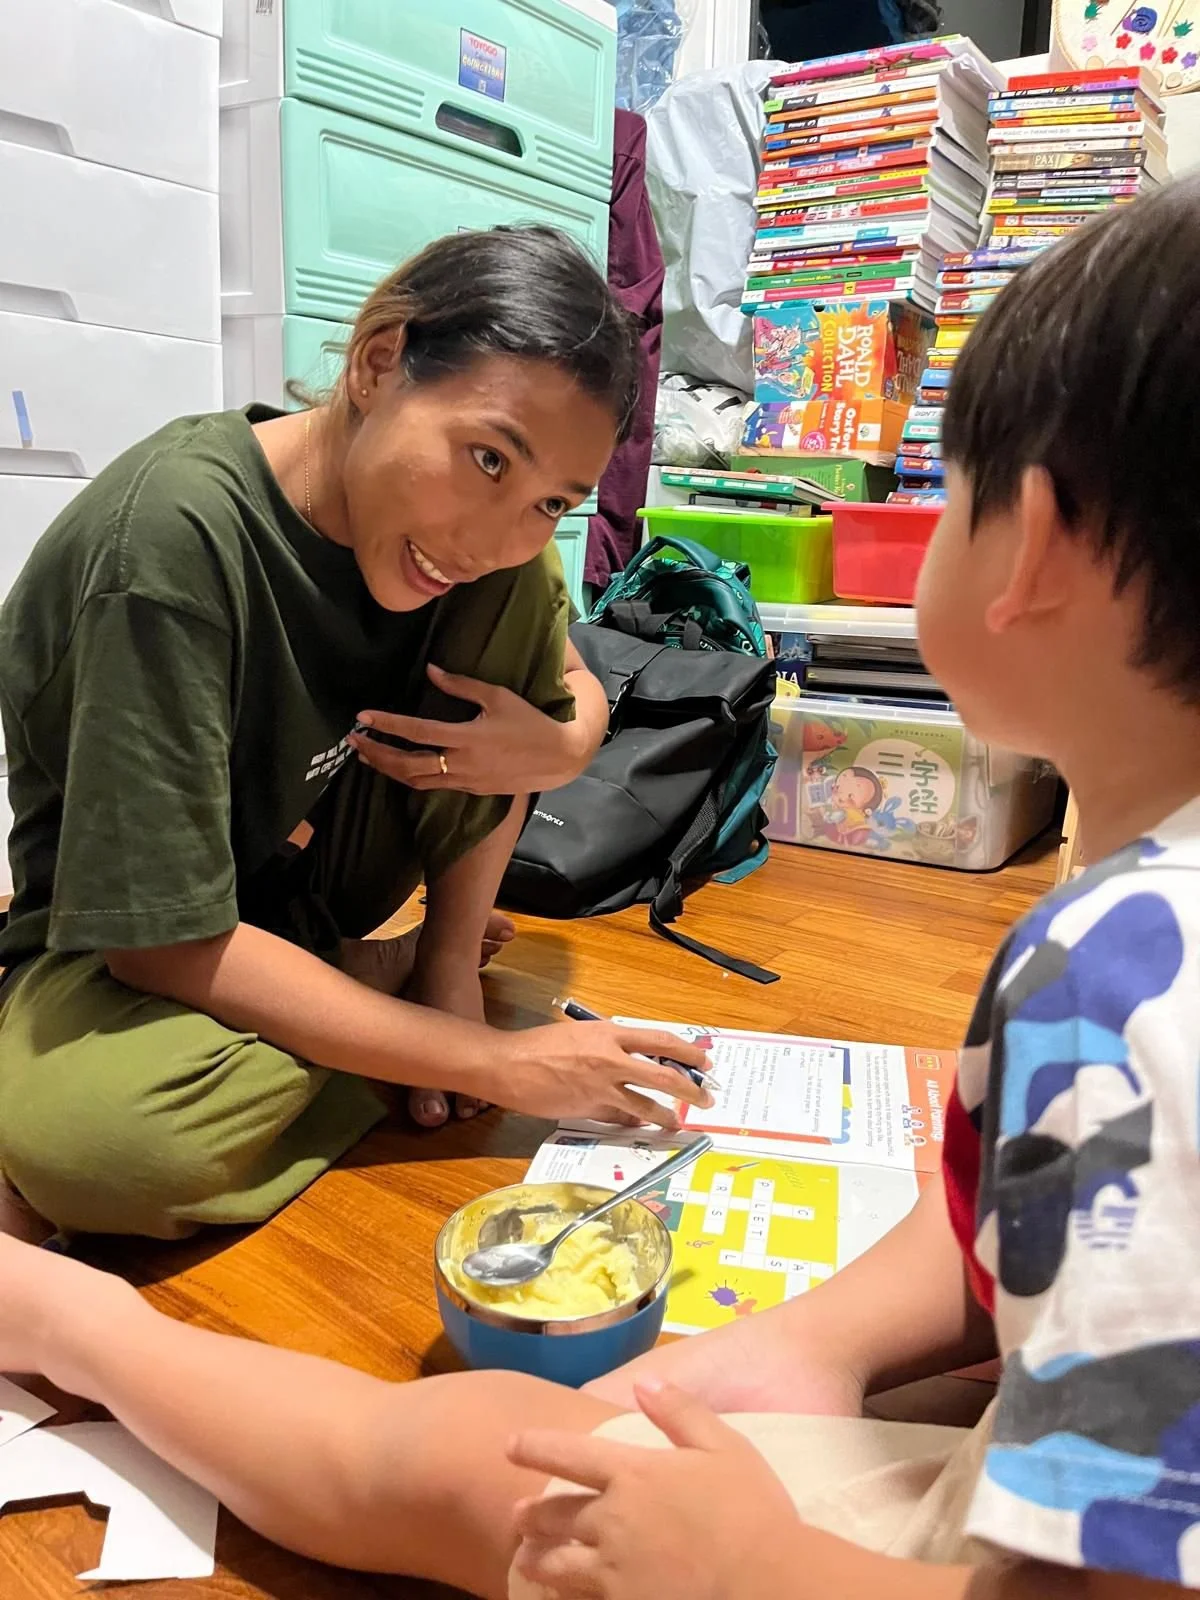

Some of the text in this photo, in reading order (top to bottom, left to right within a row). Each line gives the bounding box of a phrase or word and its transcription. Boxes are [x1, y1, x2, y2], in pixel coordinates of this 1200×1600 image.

[469, 37, 498, 57] TOYOGO
[1034, 154, 1054, 165] PAX
[821, 320, 836, 393] COLLECTION
[835, 325, 856, 388] DAHL
[854, 323, 875, 387] ROALD
[830, 402, 846, 435] Story
[533, 809, 565, 827] amsonite
